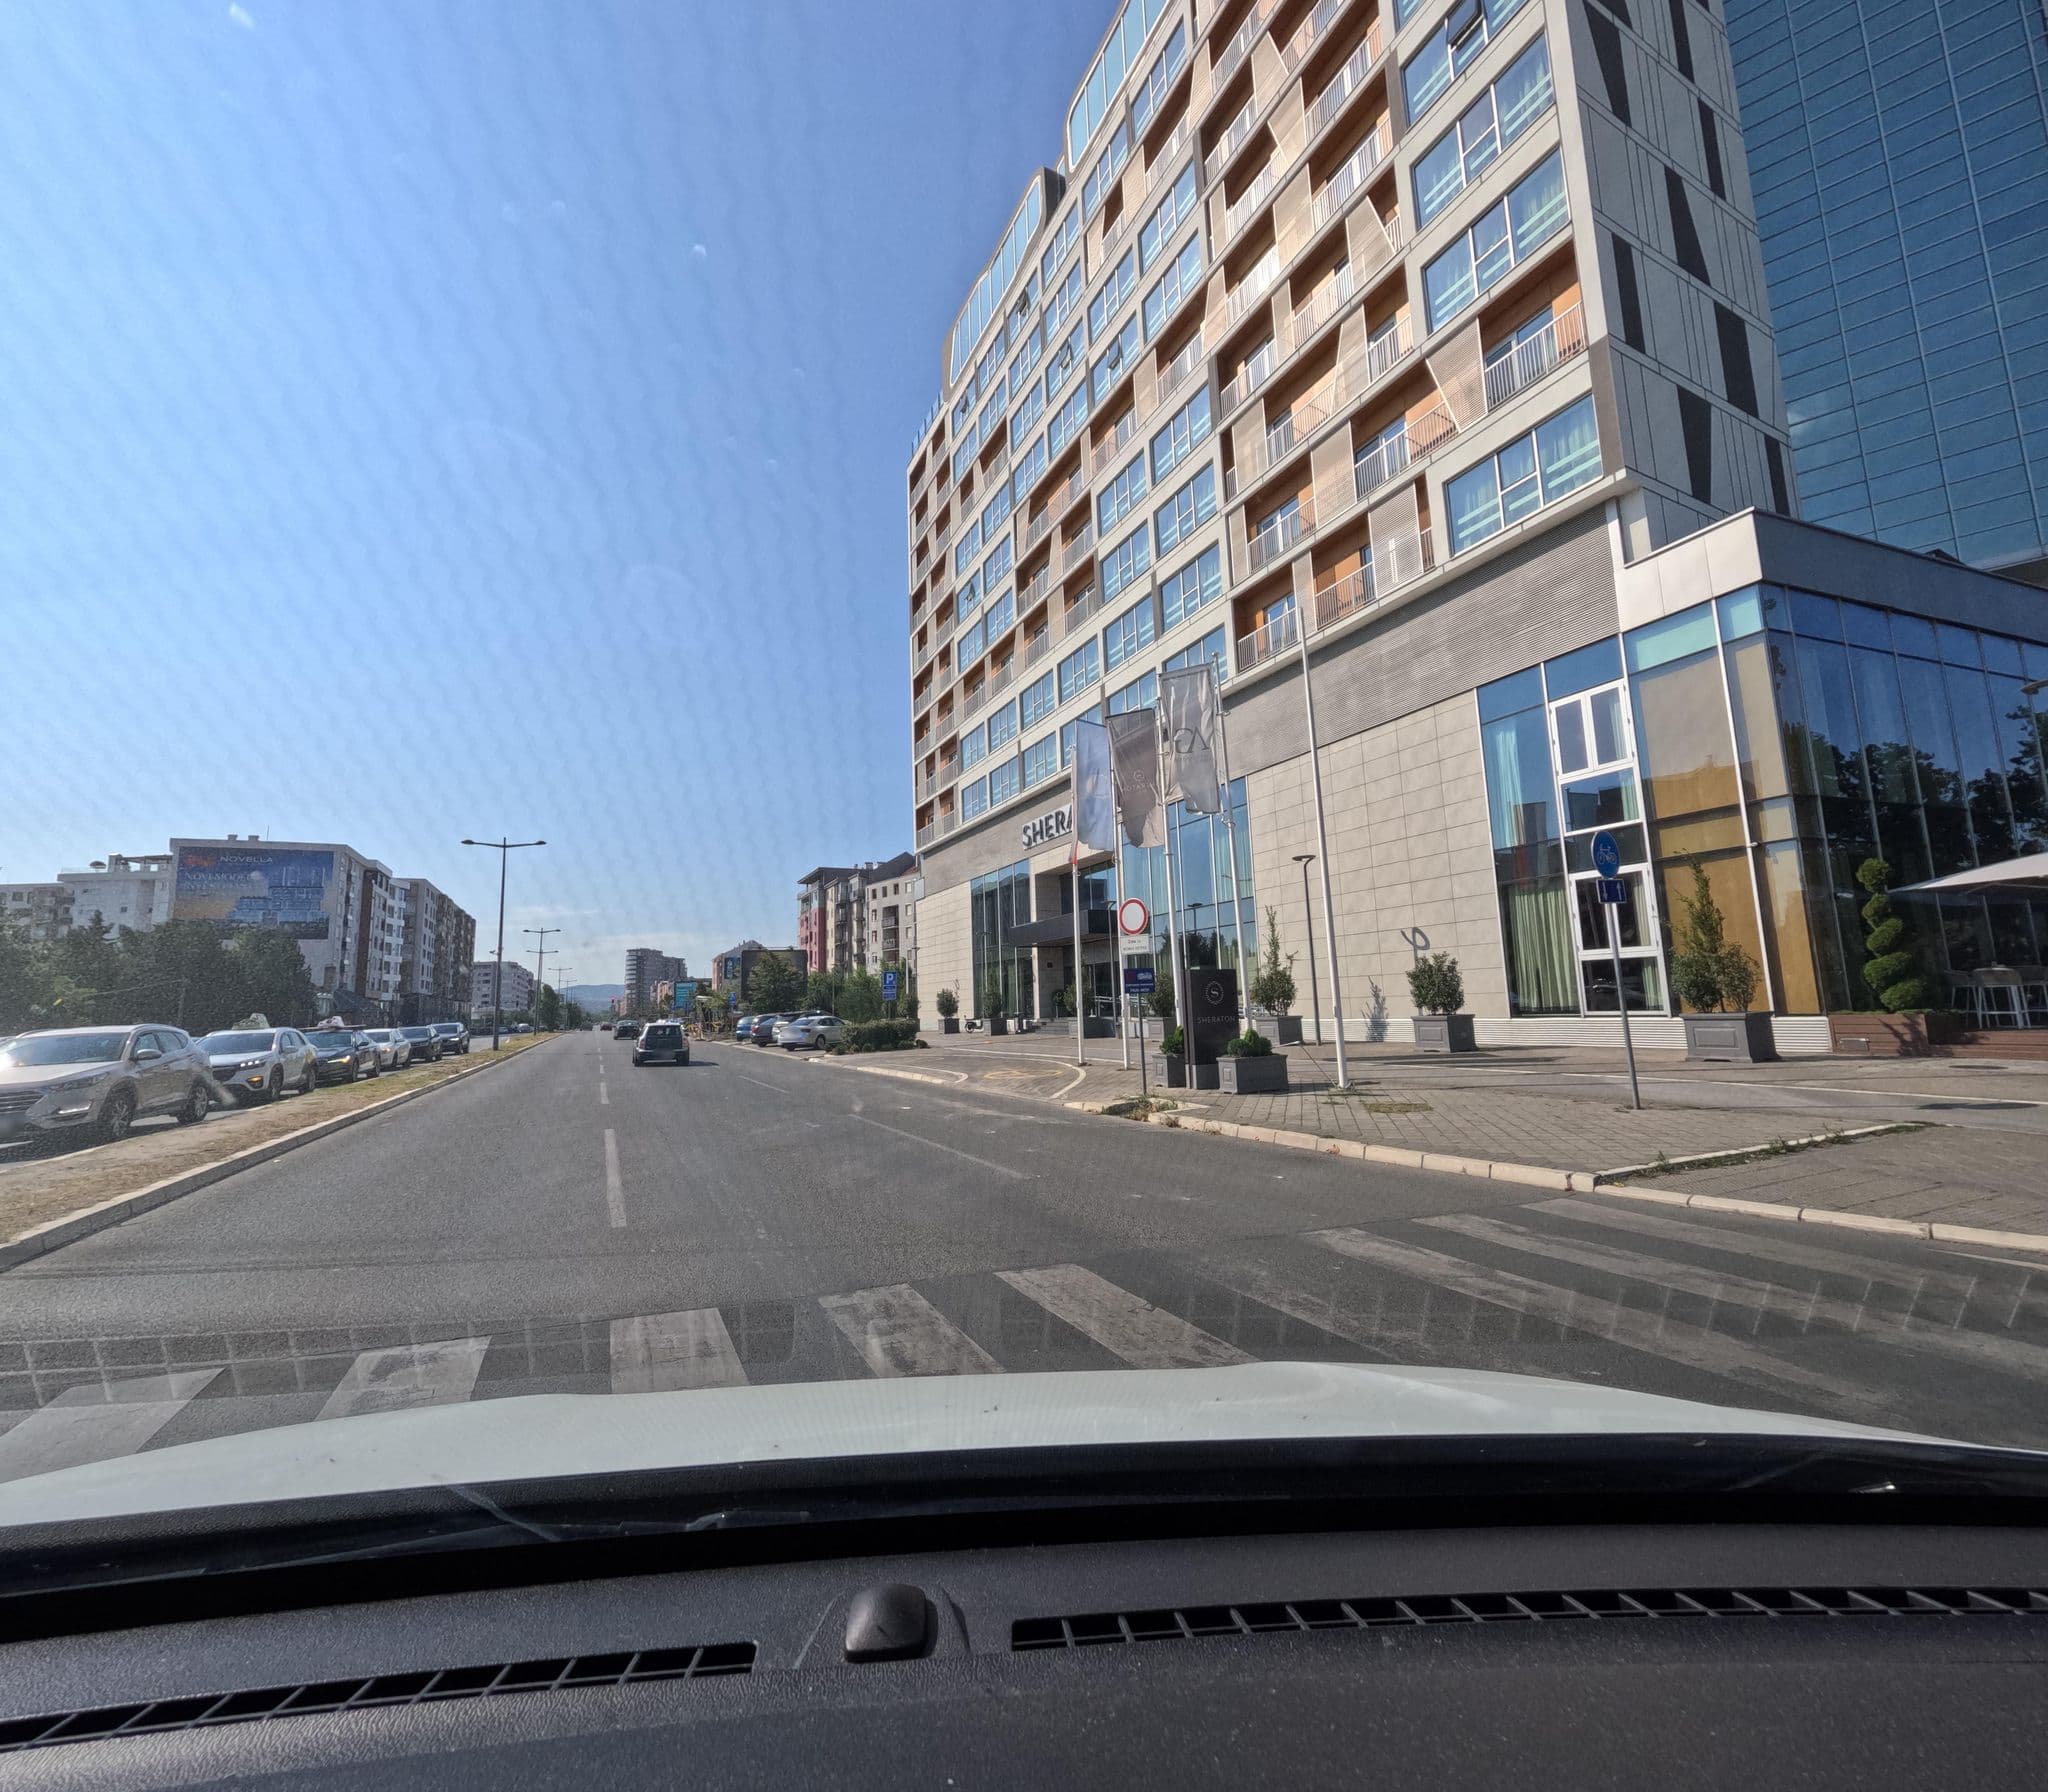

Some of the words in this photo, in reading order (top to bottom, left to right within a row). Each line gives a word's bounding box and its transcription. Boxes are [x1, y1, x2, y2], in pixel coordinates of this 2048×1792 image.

[219, 855, 273, 863] NOVELLA
[886, 973, 894, 984] P
[1197, 1016, 1236, 1024] SHERATON
